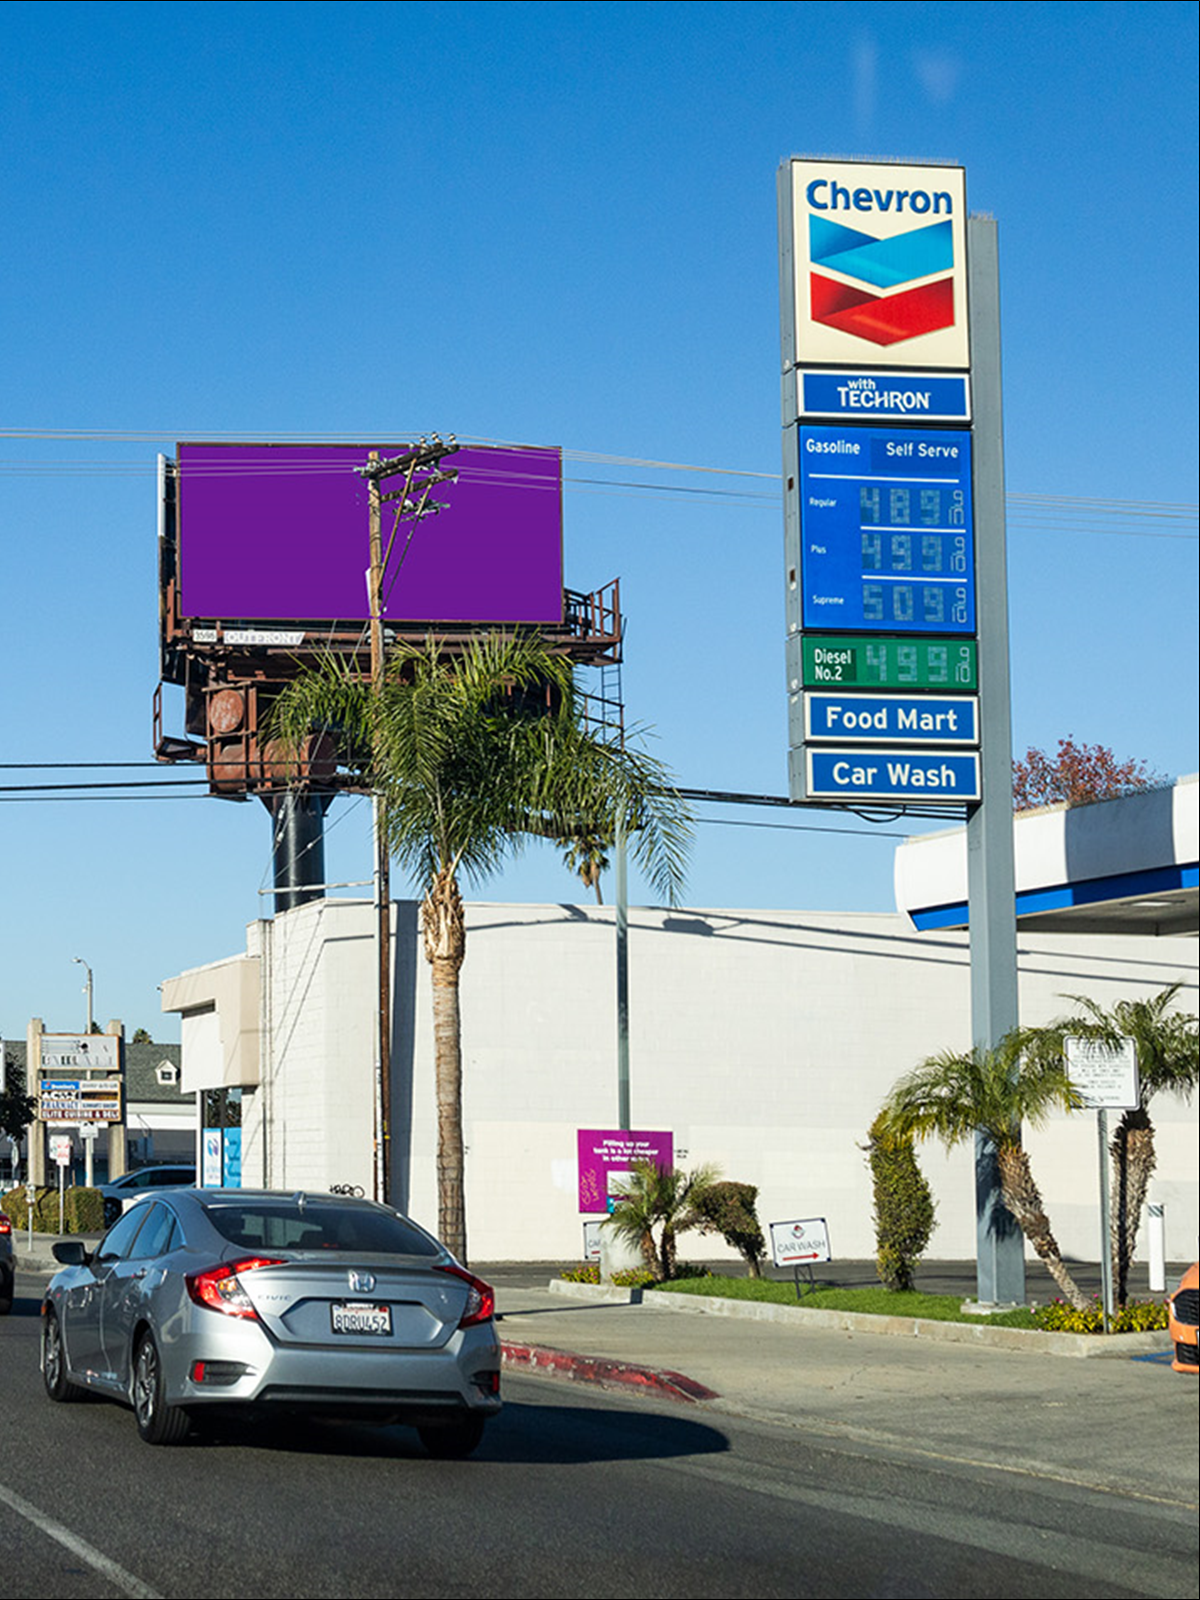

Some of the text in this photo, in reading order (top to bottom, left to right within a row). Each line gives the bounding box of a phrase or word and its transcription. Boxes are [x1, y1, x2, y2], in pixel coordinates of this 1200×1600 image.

[806, 179, 953, 214] Chevron
[847, 379, 876, 390] with
[837, 387, 930, 412] TECHRON
[806, 438, 860, 454] Gasoline
[886, 442, 959, 458] Self Serve
[809, 497, 837, 508] Regular
[811, 545, 827, 554] Plus
[812, 595, 844, 605] Supreme
[814, 649, 851, 664] Diesel
[815, 666, 842, 681] No.2
[826, 706, 958, 731] Food Mart
[833, 762, 956, 787] Car Wash
[777, 1240, 826, 1253] CAR WASH
